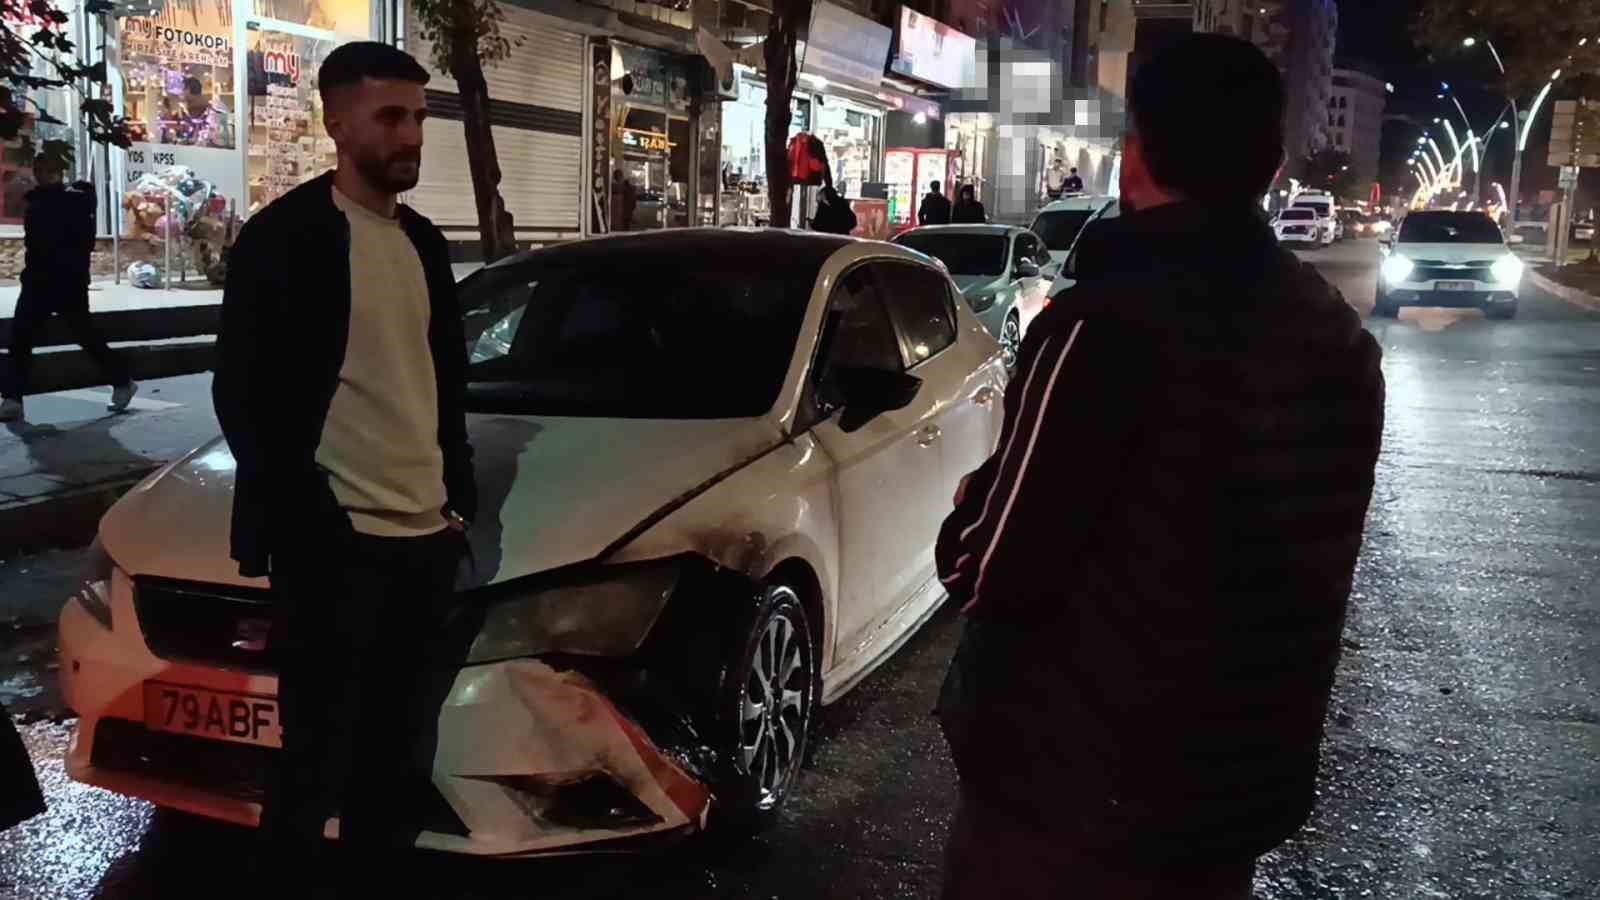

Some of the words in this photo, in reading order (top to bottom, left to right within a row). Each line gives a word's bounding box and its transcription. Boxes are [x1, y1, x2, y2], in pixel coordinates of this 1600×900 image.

[266, 52, 299, 82] my
[127, 150, 144, 164] YDS
[153, 152, 175, 165] KPSS
